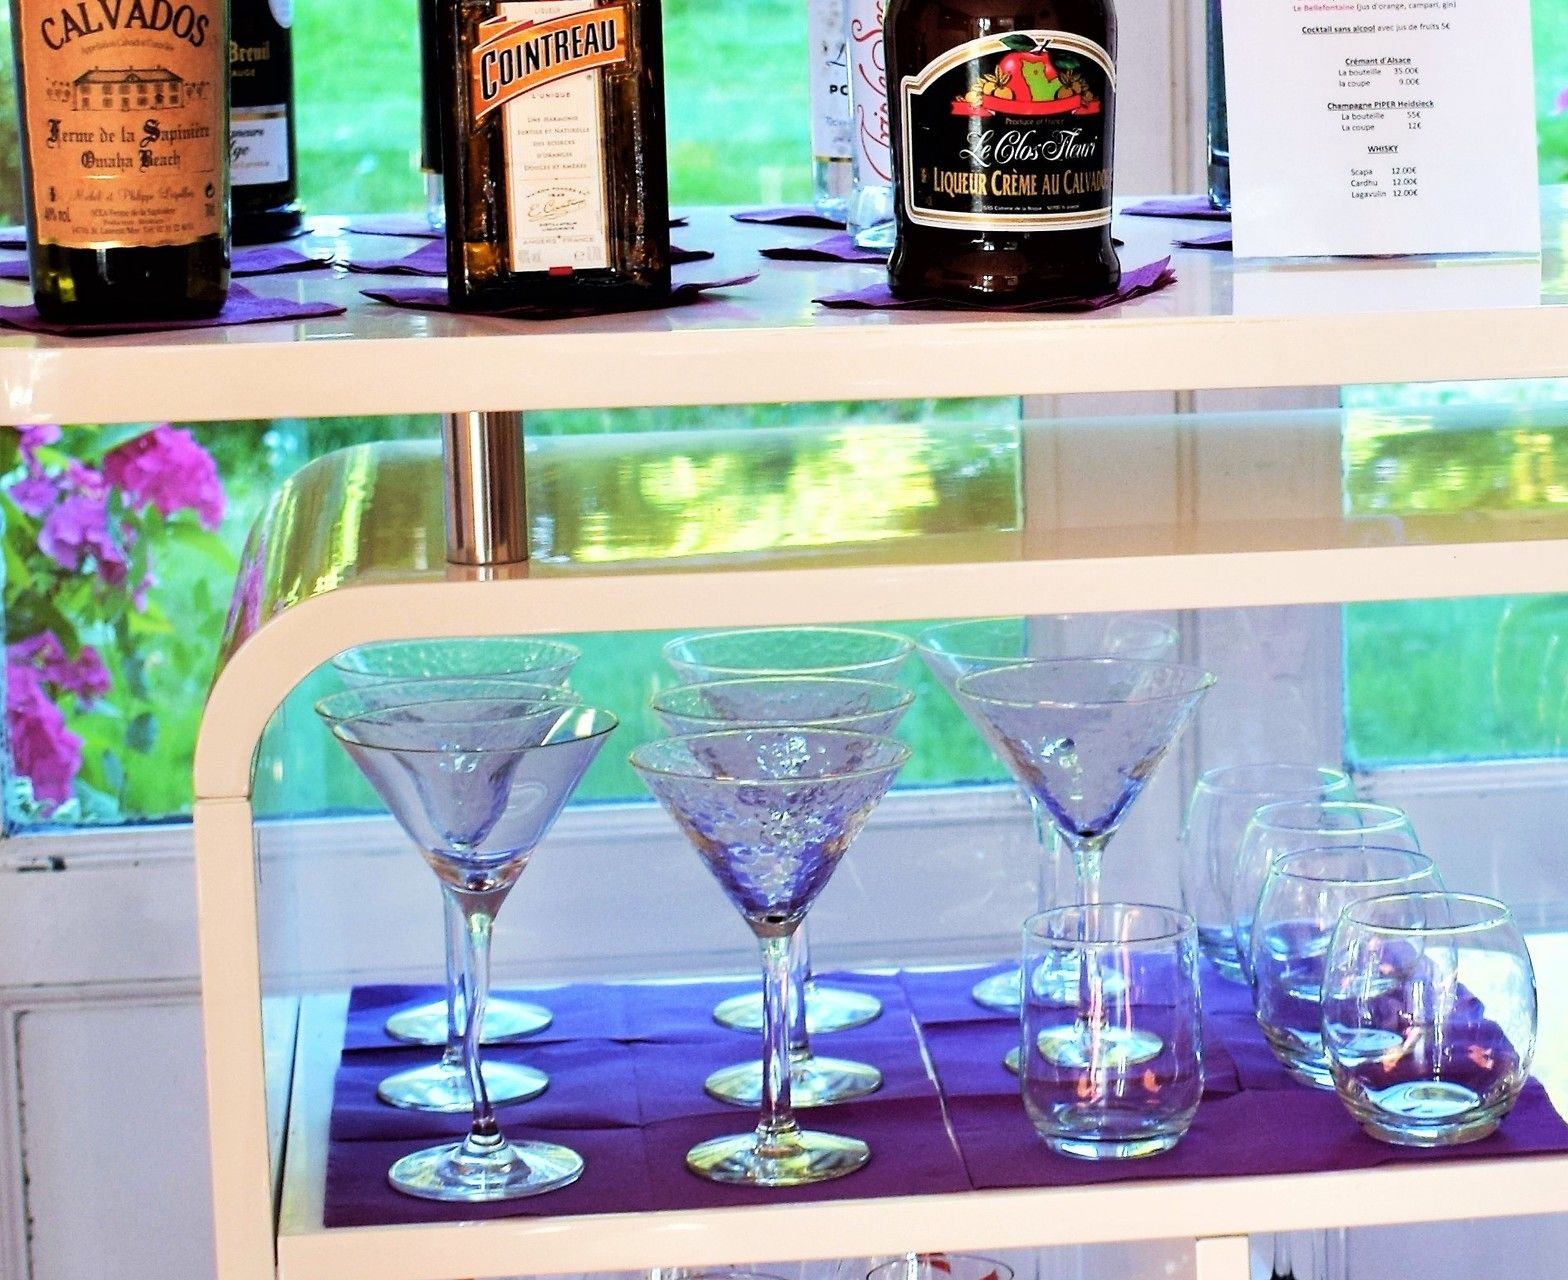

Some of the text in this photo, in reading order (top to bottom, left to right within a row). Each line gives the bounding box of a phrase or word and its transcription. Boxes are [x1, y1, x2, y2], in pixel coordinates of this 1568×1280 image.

[1302, 26, 1333, 34] Cocktail
[1353, 25, 1376, 33] alcool
[481, 19, 616, 100] COINTREAU
[1345, 58, 1378, 66] Crémant
[1348, 68, 1382, 76] bouteille
[1347, 80, 1371, 88] coupe
[1327, 102, 1372, 110] Champagne
[1398, 100, 1435, 108] Heidsieck
[1352, 112, 1385, 120] bouteille
[1005, 118, 1034, 126] Produce
[1352, 122, 1422, 132] coupe 12€
[47, 119, 95, 149] Ferme
[100, 127, 115, 143] de
[121, 126, 135, 143] la
[959, 130, 994, 167] Le
[994, 130, 1042, 164] Clos
[1367, 145, 1398, 153] WHISKY
[81, 149, 181, 173] Omaha Beach
[1350, 167, 1417, 177] Scapa 12.00€
[933, 166, 987, 197] LIQUEUR
[991, 169, 1037, 196] CRÈME
[1041, 175, 1059, 195] AU
[1350, 178, 1418, 187] Cardhu 12.00€
[1351, 189, 1418, 199] Lagavulin 12.00€
